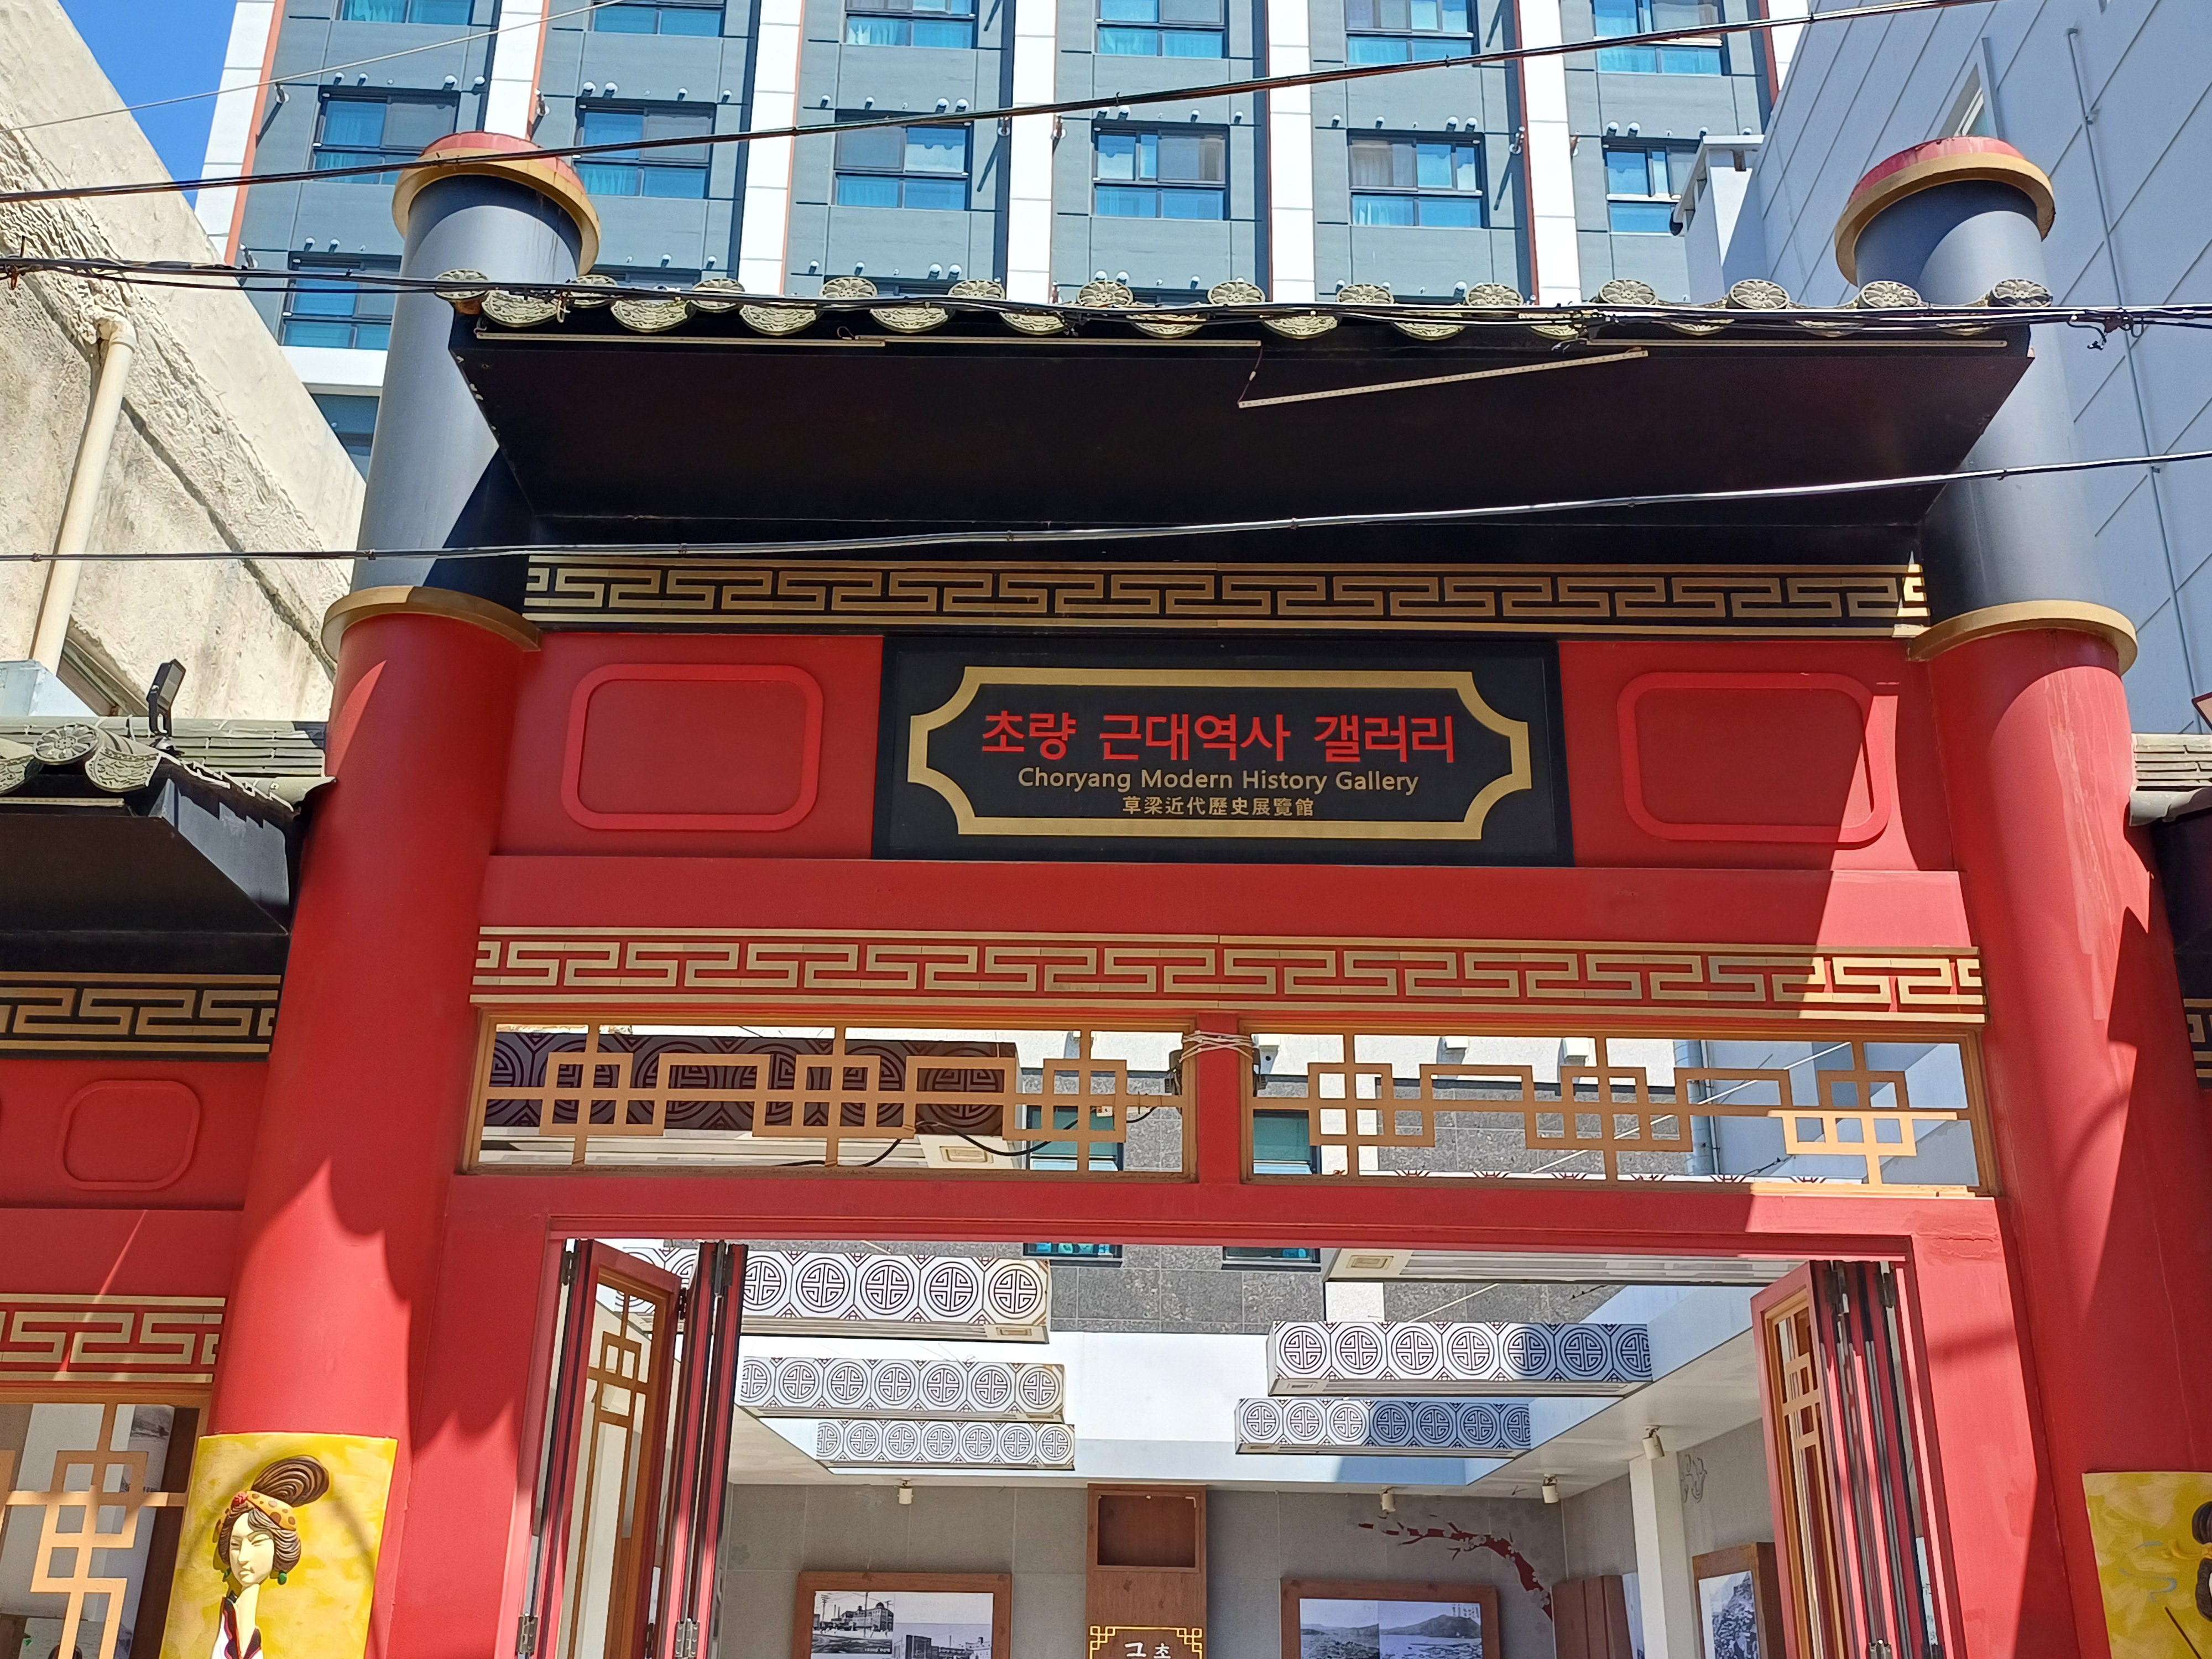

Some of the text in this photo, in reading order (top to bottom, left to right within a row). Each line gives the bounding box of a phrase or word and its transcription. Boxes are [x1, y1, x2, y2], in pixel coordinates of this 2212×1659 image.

[982, 710, 1454, 763] 초량 근대역사 갤러리
[1018, 767, 1419, 796] Choryang Modern History Gallery
